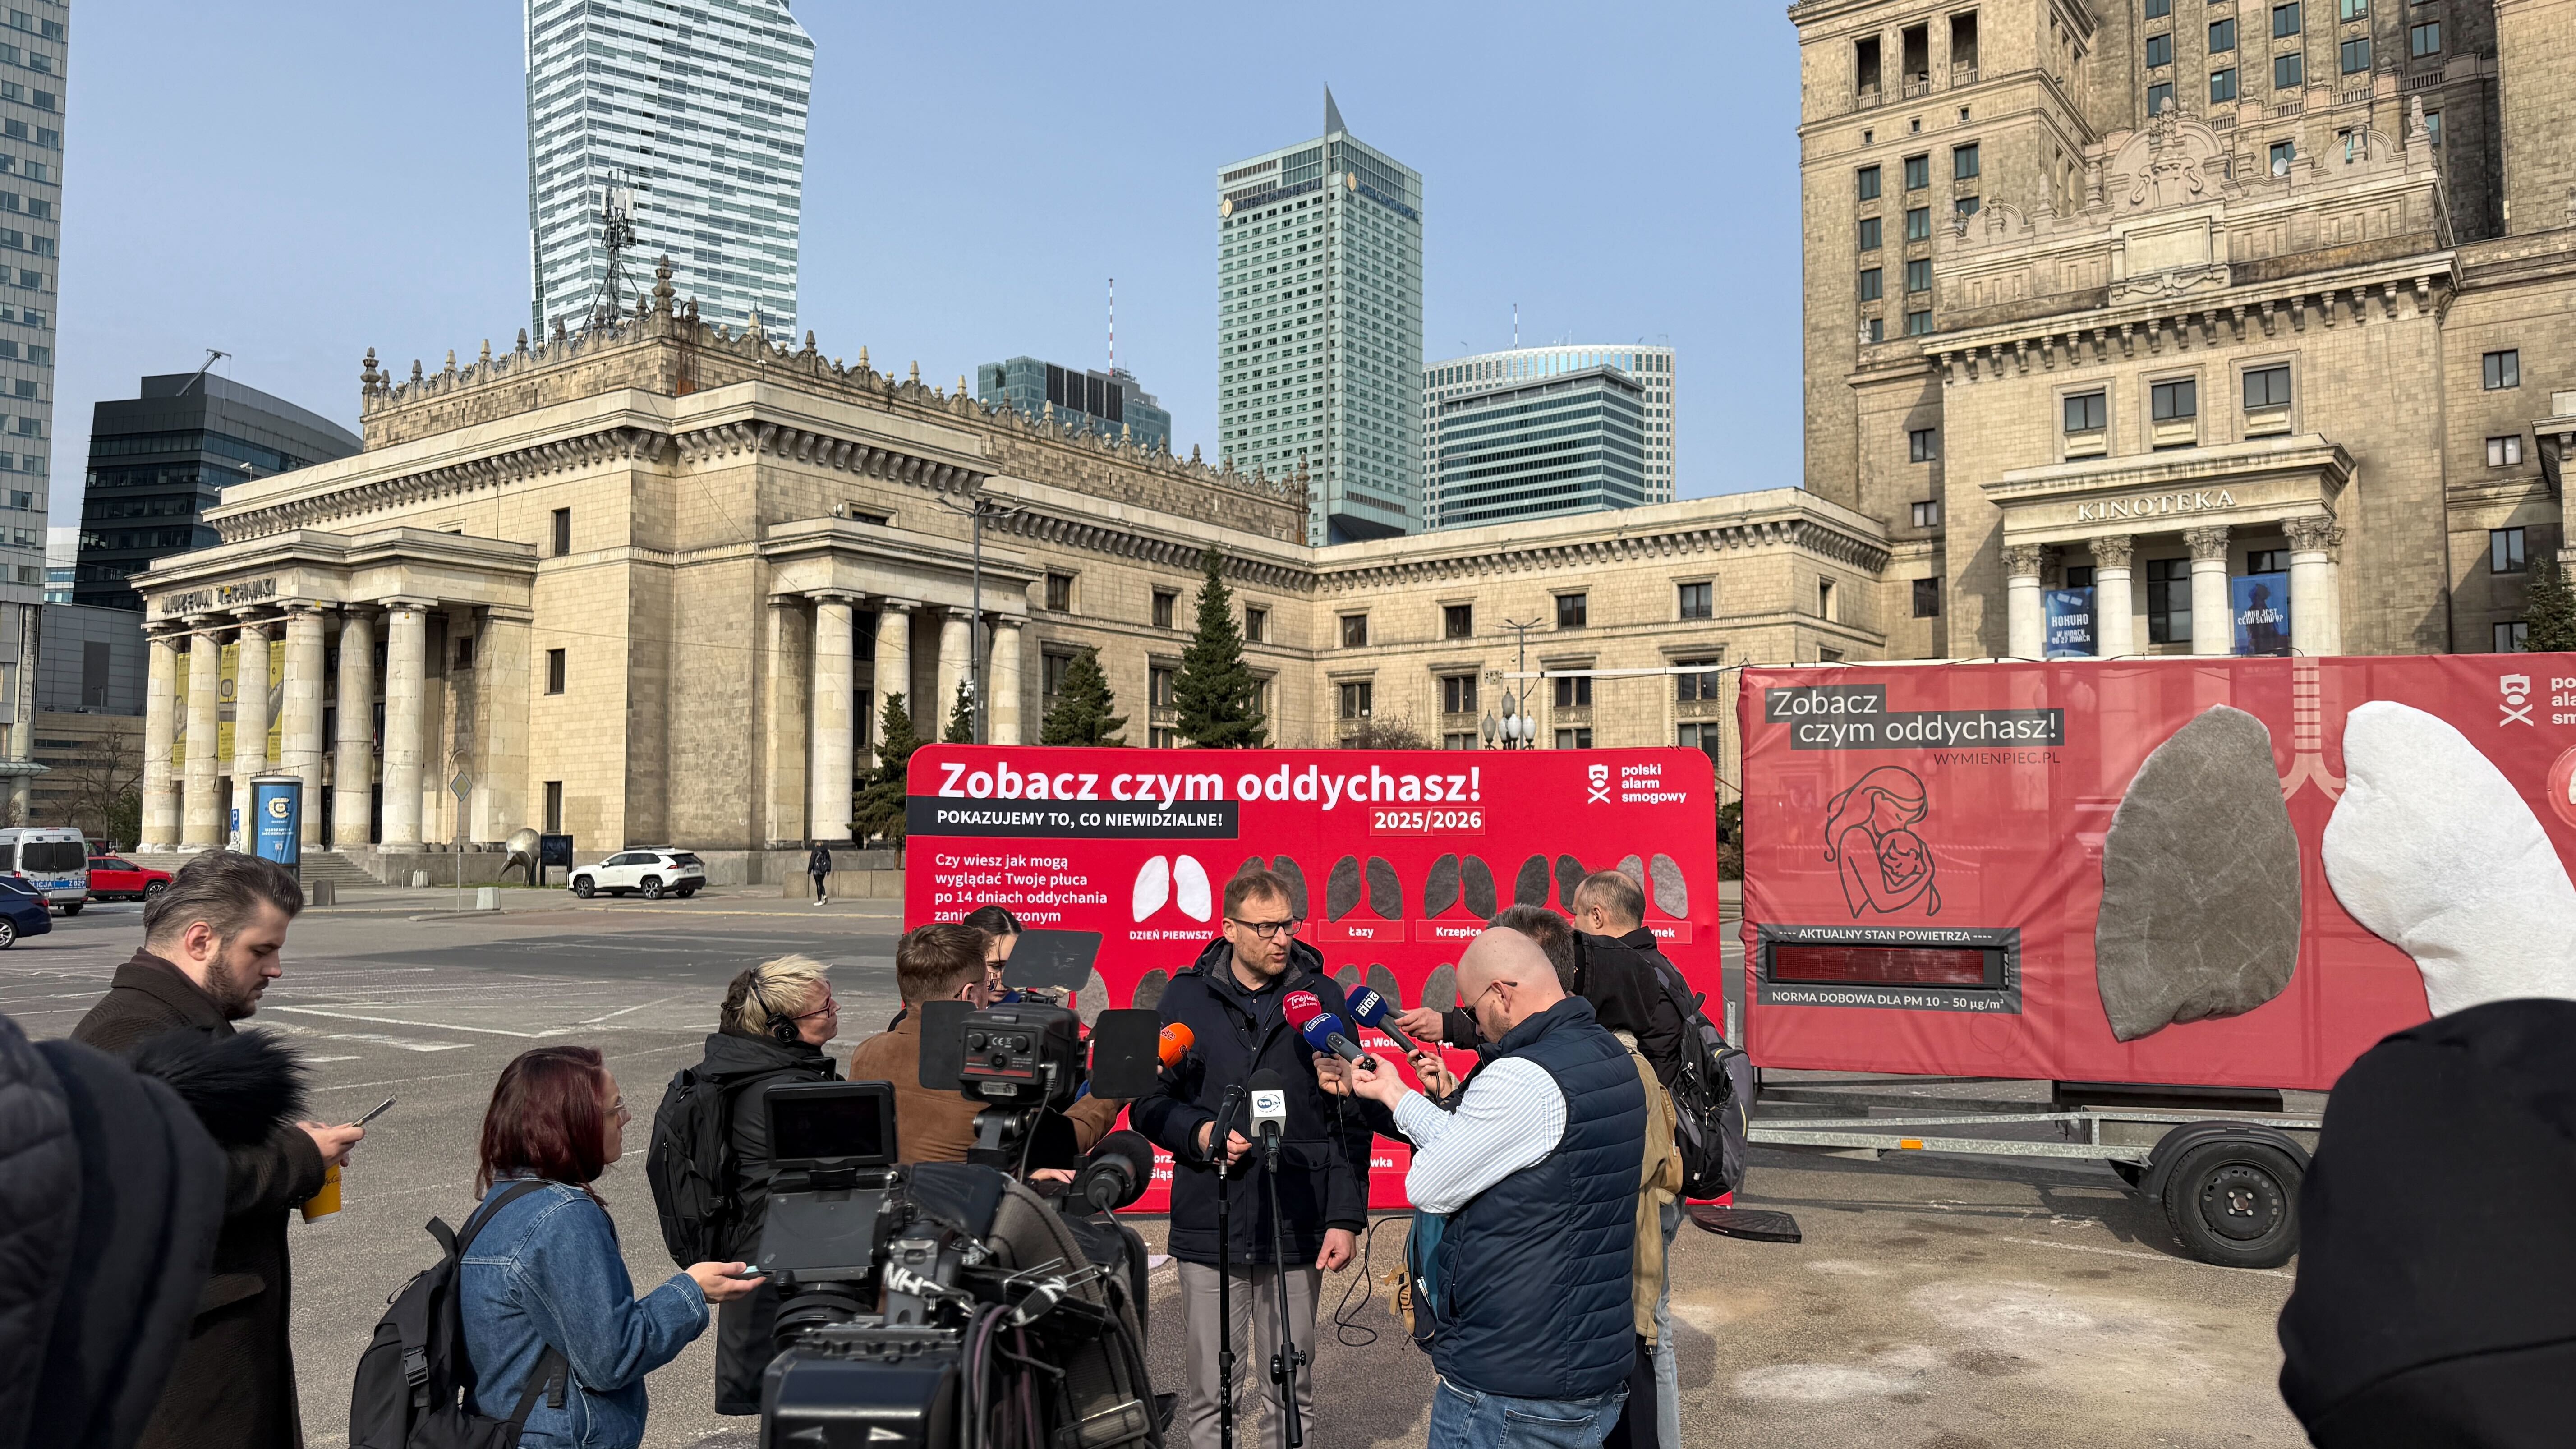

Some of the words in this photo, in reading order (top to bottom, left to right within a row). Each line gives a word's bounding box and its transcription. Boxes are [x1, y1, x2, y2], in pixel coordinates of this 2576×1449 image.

[1358, 181, 1418, 221] INTERCONTINENTAL
[2078, 488, 2236, 521] KINOTEKA
[162, 589, 212, 615] MUZEUM
[216, 577, 276, 605] TECHNIKI
[2052, 613, 2089, 627] KOKUHO
[2061, 636, 2068, 644] 27
[2069, 634, 2091, 643] MARCA
[1773, 690, 1878, 716] Zobacz
[1799, 722, 1875, 747] czym
[1886, 712, 2056, 746] oddychasz!
[1933, 751, 2061, 765] WYMIENPIEC.PL
[1621, 763, 1661, 778] polski
[938, 761, 1099, 801] Zobacz
[1110, 773, 1224, 810] czym
[1237, 764, 1481, 811] oddychasz!
[1621, 777, 1660, 789] alarm
[1621, 792, 1687, 805] smogowy
[937, 810, 1045, 826] POKAZUJEMY
[1048, 812, 1075, 829] TO,
[1079, 813, 1101, 827] CO
[1105, 813, 1223, 827] NIEWIDZIALNE!
[1374, 810, 1482, 833] 2025/2026
[935, 853, 960, 869] Czy
[963, 853, 1003, 867] wiesz
[1004, 854, 1027, 870] jak
[1030, 856, 1069, 871] mogą
[935, 871, 1002, 888] wyglądać
[1005, 872, 1047, 888] Twoje
[1050, 873, 1088, 888] płuca
[935, 892, 953, 906] po
[957, 891, 973, 903] 14
[976, 890, 1023, 903] dniach
[1026, 891, 1108, 906] oddychania
[1129, 929, 1160, 940] DZIEŃ
[1162, 930, 1214, 940] PIERWSZY
[1348, 926, 1374, 939] Łazy
[1435, 926, 1482, 939] Krzepice
[1799, 929, 1863, 940] AKTUALNY
[1864, 930, 1895, 941] STAN
[1899, 930, 1971, 942] POWIETRZA
[1287, 994, 1318, 1007] Trójka
[1359, 993, 1379, 1016] RDC
[1772, 991, 1817, 1003] NORMA
[1819, 993, 1876, 1004] DOBOWA
[1877, 995, 1901, 1006] DLA
[1904, 996, 1923, 1006] PM
[1926, 996, 1940, 1007] 10
[1953, 998, 1967, 1008] 50
[1370, 1156, 1393, 1168] wka
